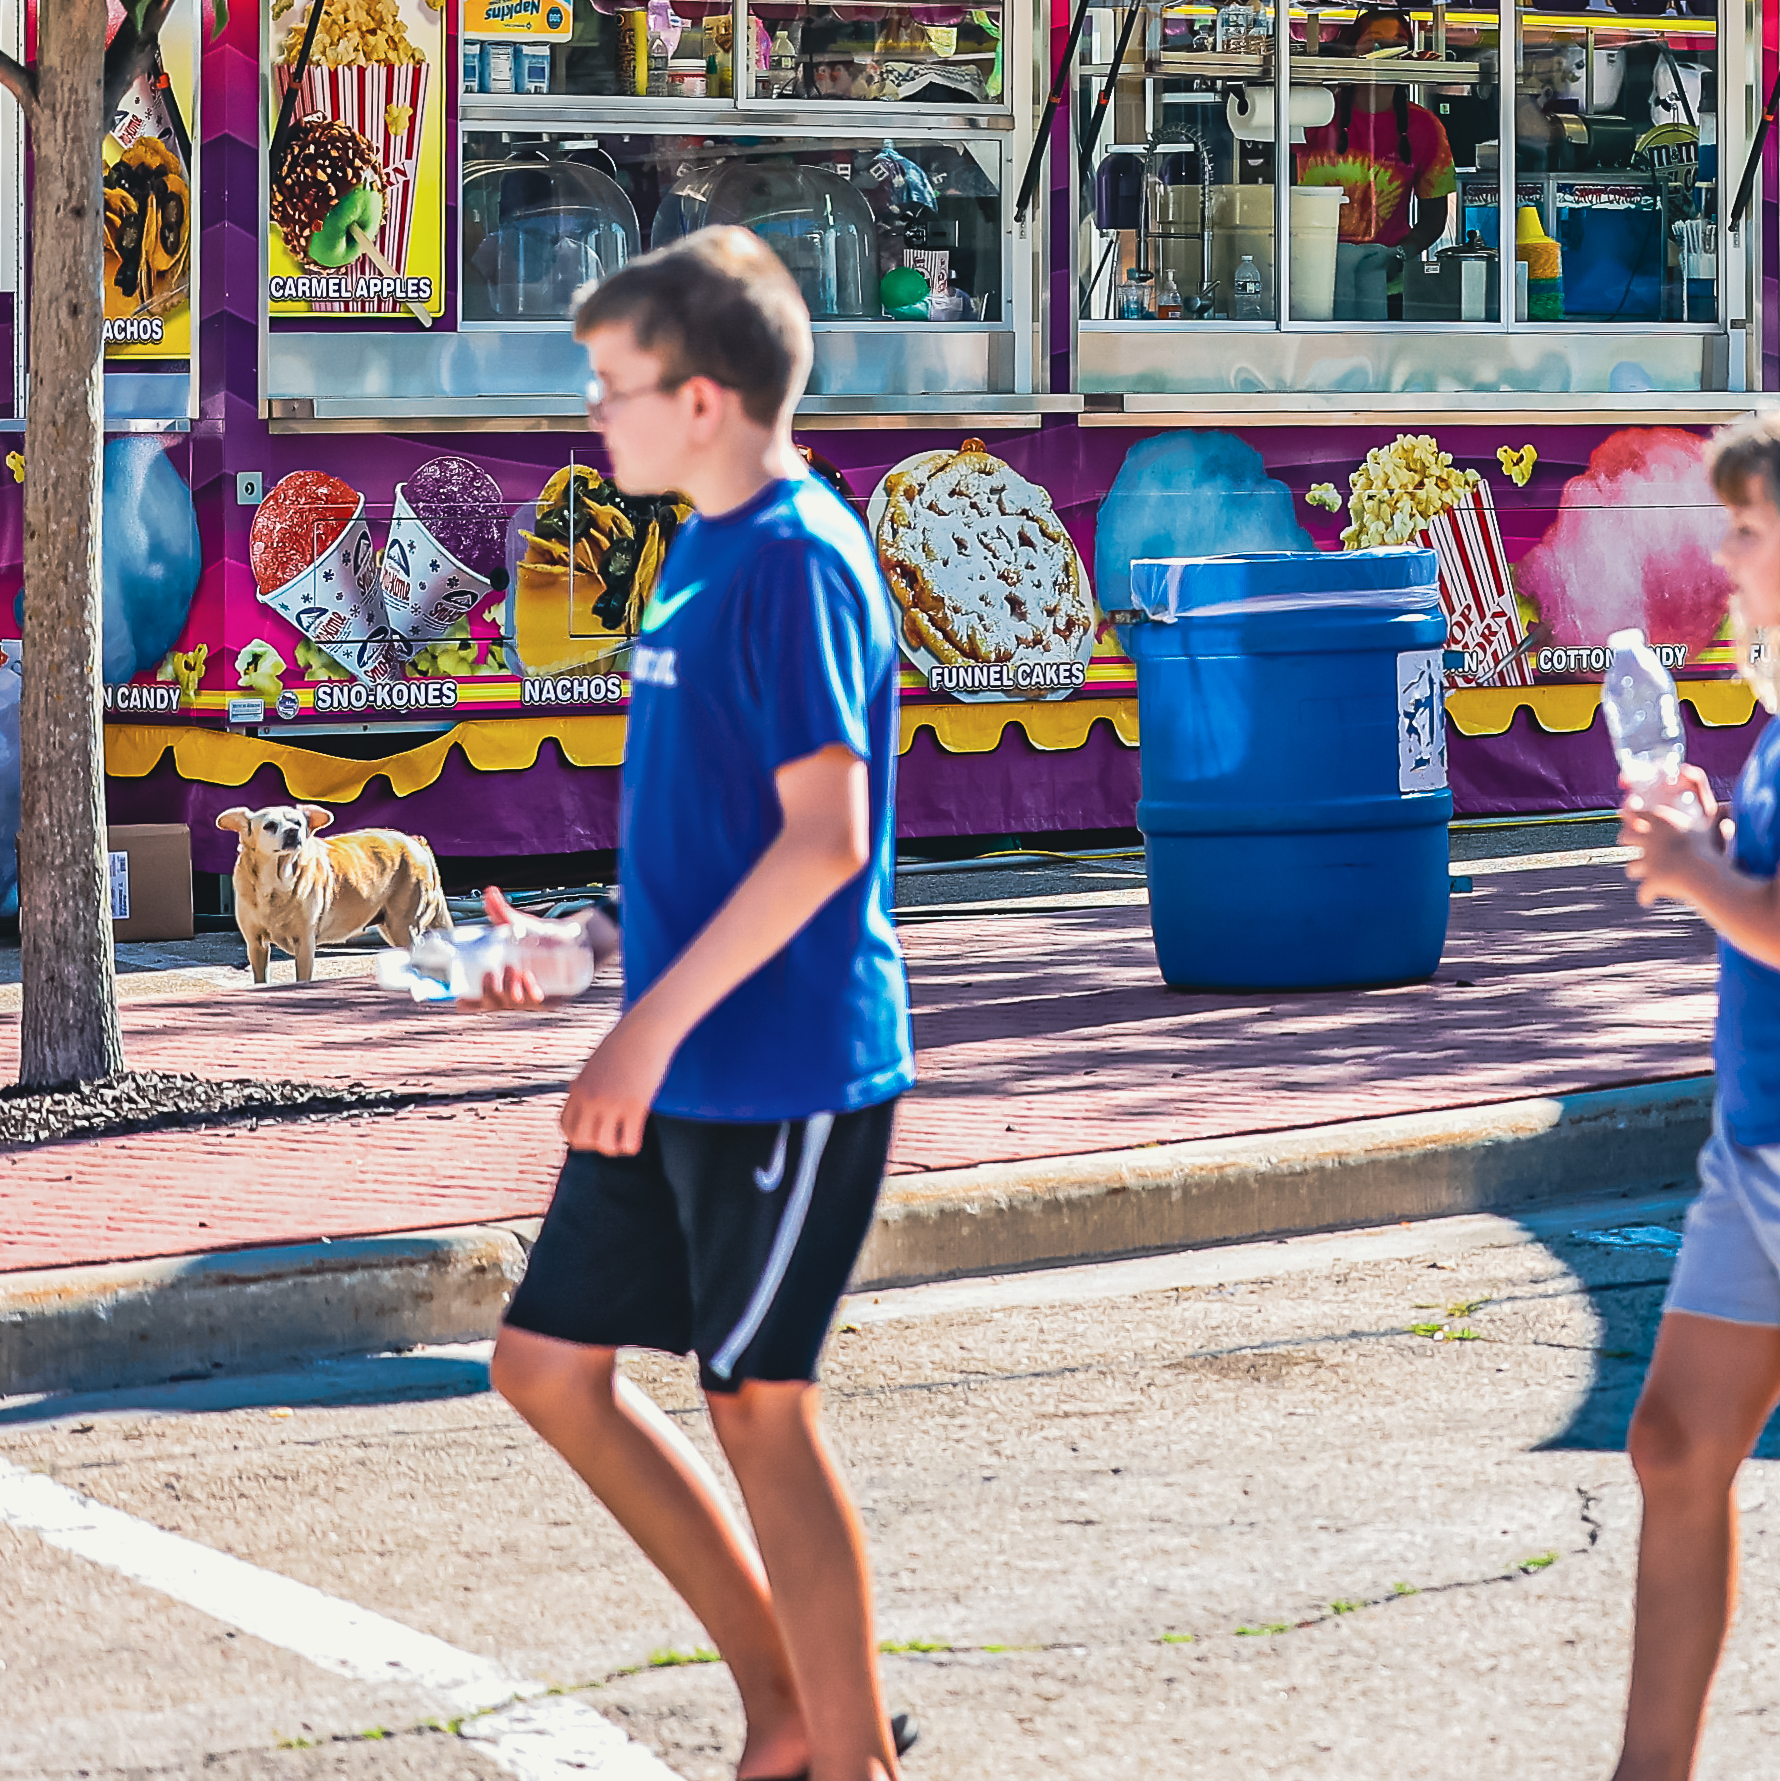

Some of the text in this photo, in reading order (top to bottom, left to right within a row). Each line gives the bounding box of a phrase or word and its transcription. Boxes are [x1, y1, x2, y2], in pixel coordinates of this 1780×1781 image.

[270, 277, 432, 300] CARMEL APPLES
[103, 317, 163, 342] ACHOS
[523, 674, 622, 703] NACHOS
[930, 661, 1086, 692] FUNNEL CAKES
[116, 685, 182, 711] CANDY
[315, 681, 458, 710] SNO-KONES
